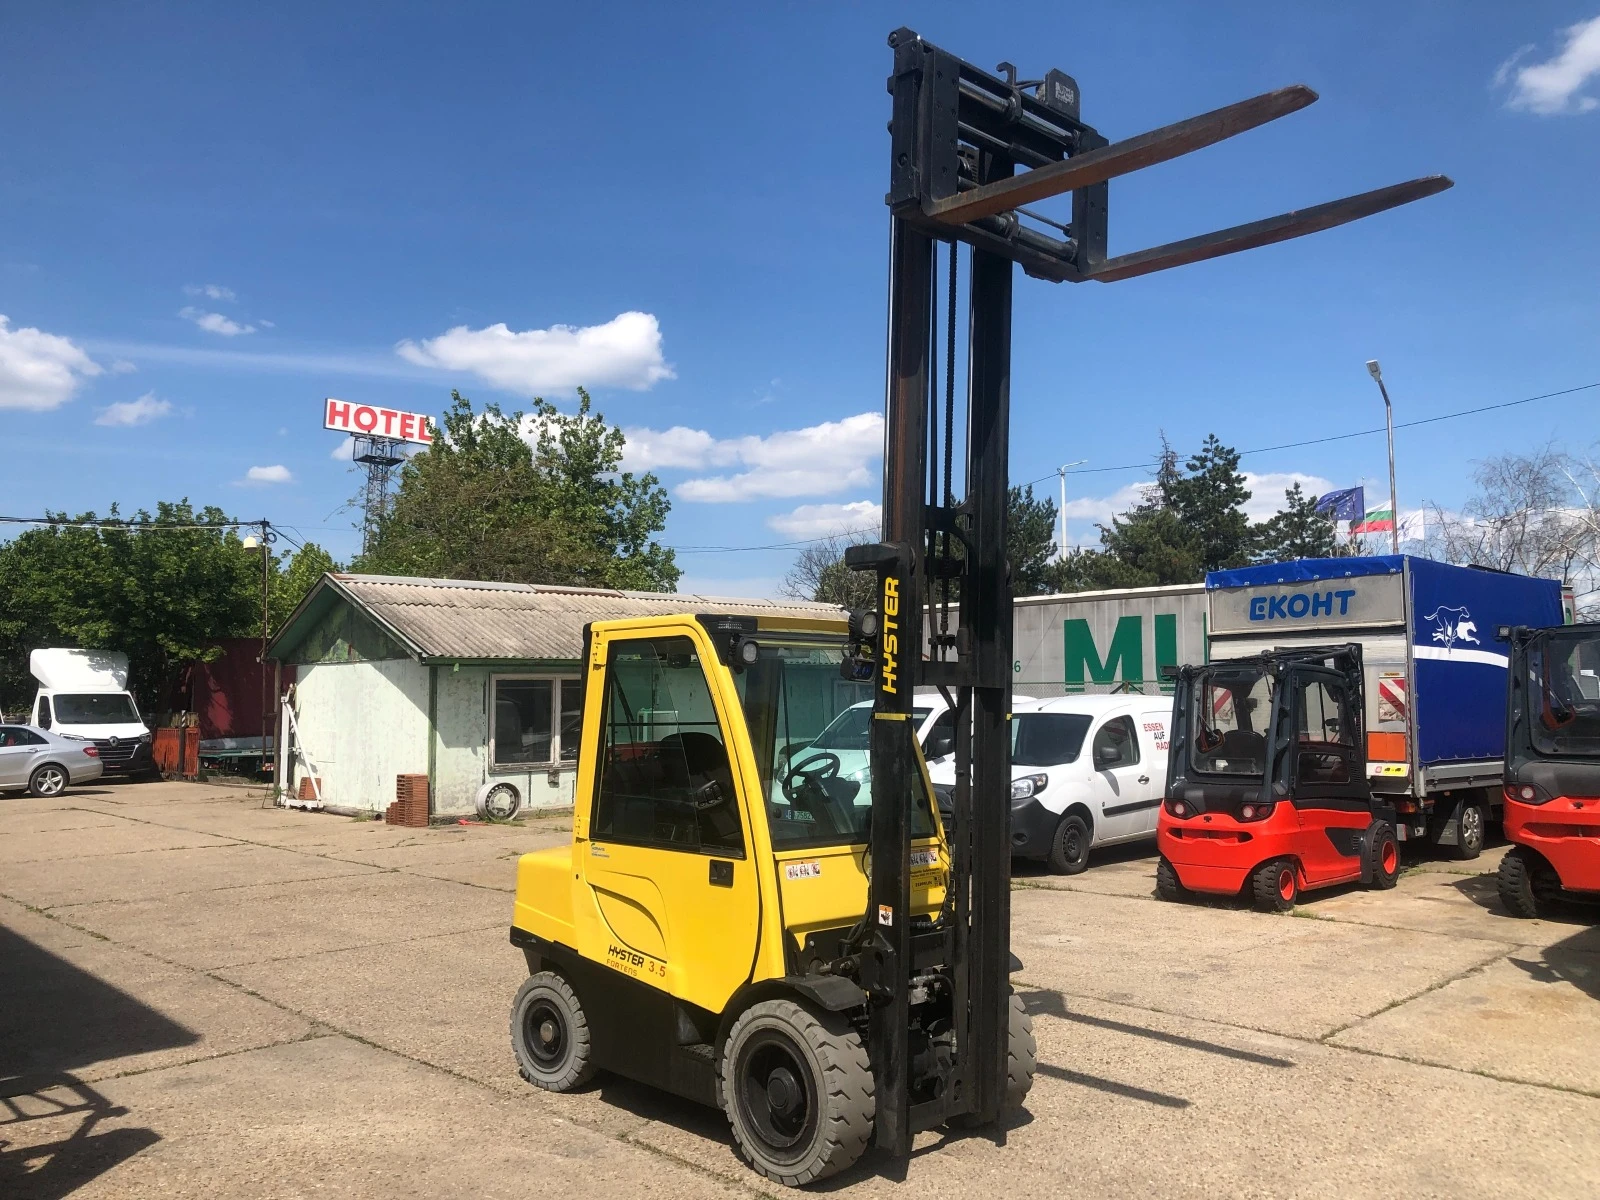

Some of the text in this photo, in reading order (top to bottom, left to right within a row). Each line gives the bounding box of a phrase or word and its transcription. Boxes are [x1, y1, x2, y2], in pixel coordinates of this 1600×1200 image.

[328, 401, 433, 442] HOTEL
[882, 577, 899, 694] HYSTER
[1143, 722, 1164, 732] ESSEN
[1153, 731, 1165, 741] AUF
[606, 958, 638, 977] FORTENS
[608, 944, 666, 978] HYSTER 3.5
